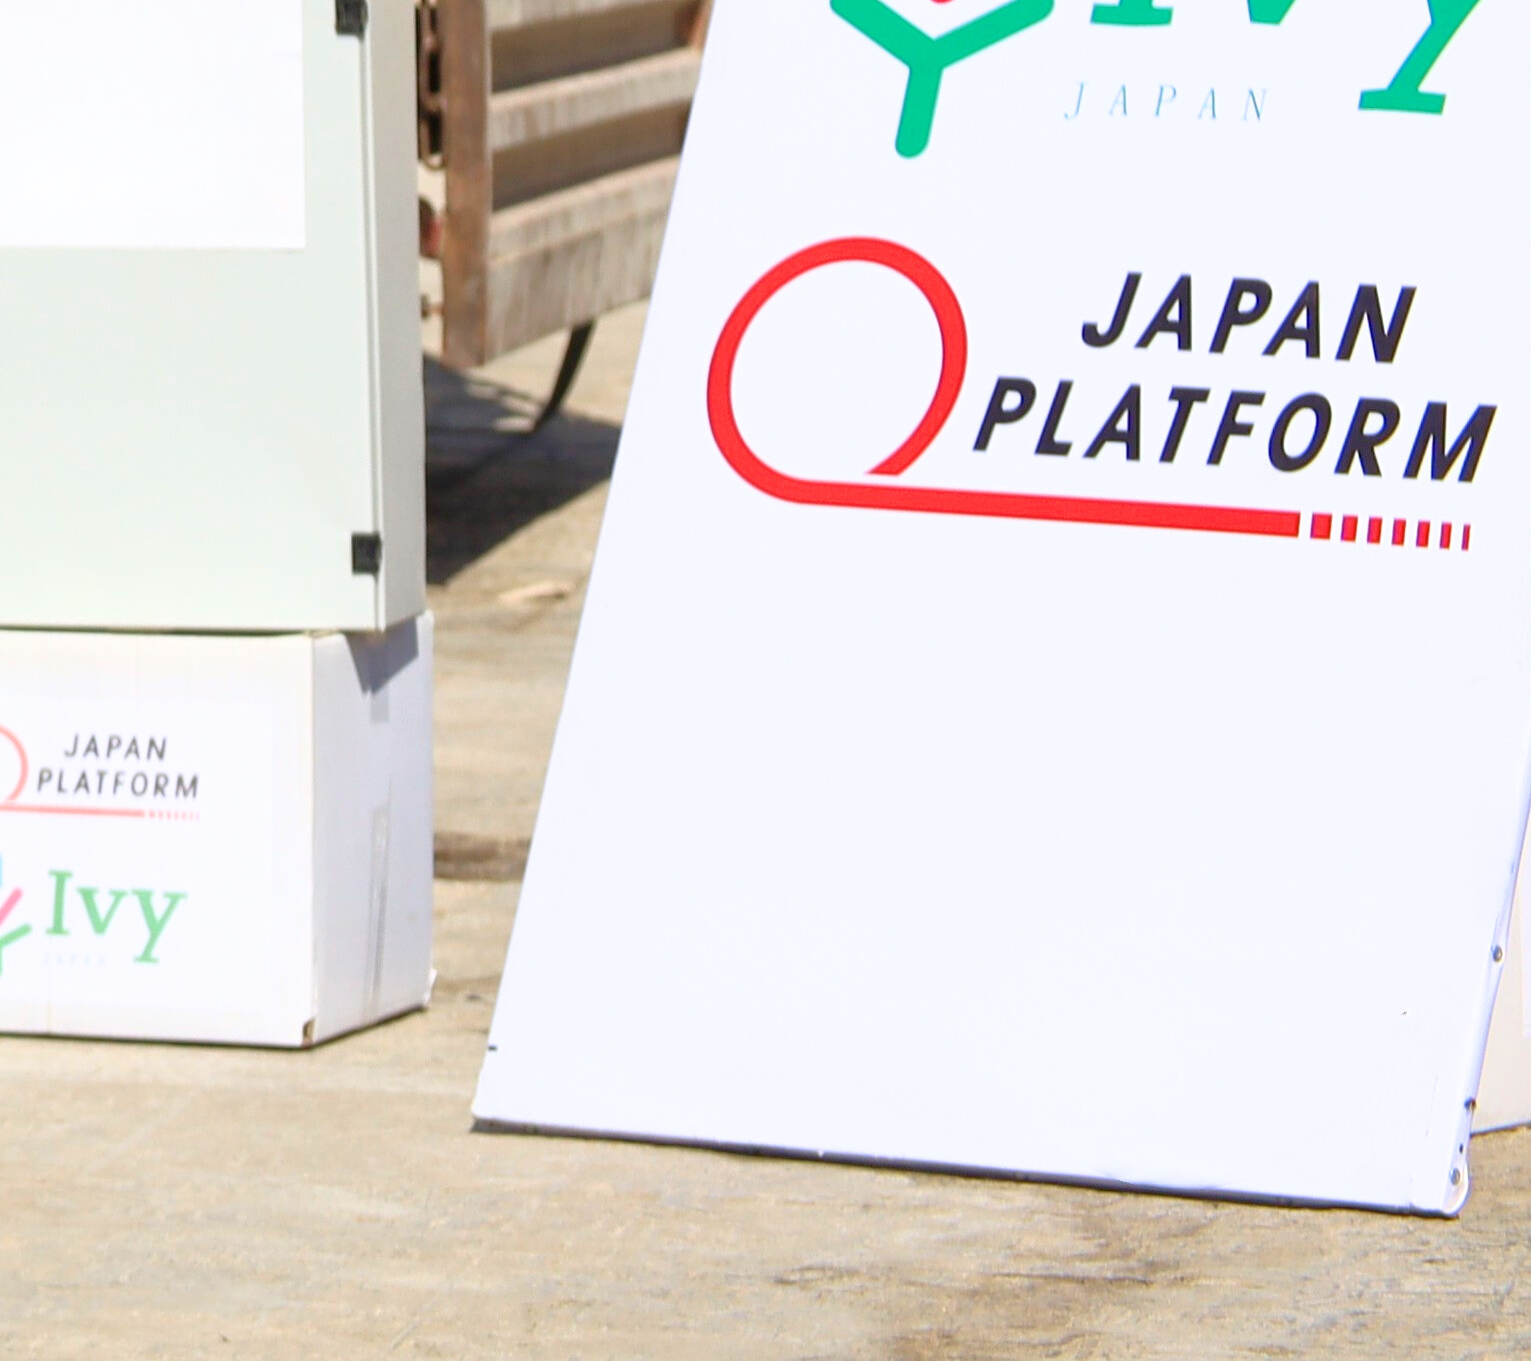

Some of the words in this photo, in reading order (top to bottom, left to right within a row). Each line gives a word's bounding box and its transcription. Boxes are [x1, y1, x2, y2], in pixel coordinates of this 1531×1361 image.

[1063, 82, 1269, 125] JAPAN
[1081, 272, 1418, 365] JAPAN
[973, 376, 1498, 484] PLATFORM
[64, 734, 168, 762] JAPAN
[36, 769, 200, 798] PLATFORM
[45, 869, 188, 964] Ivy
